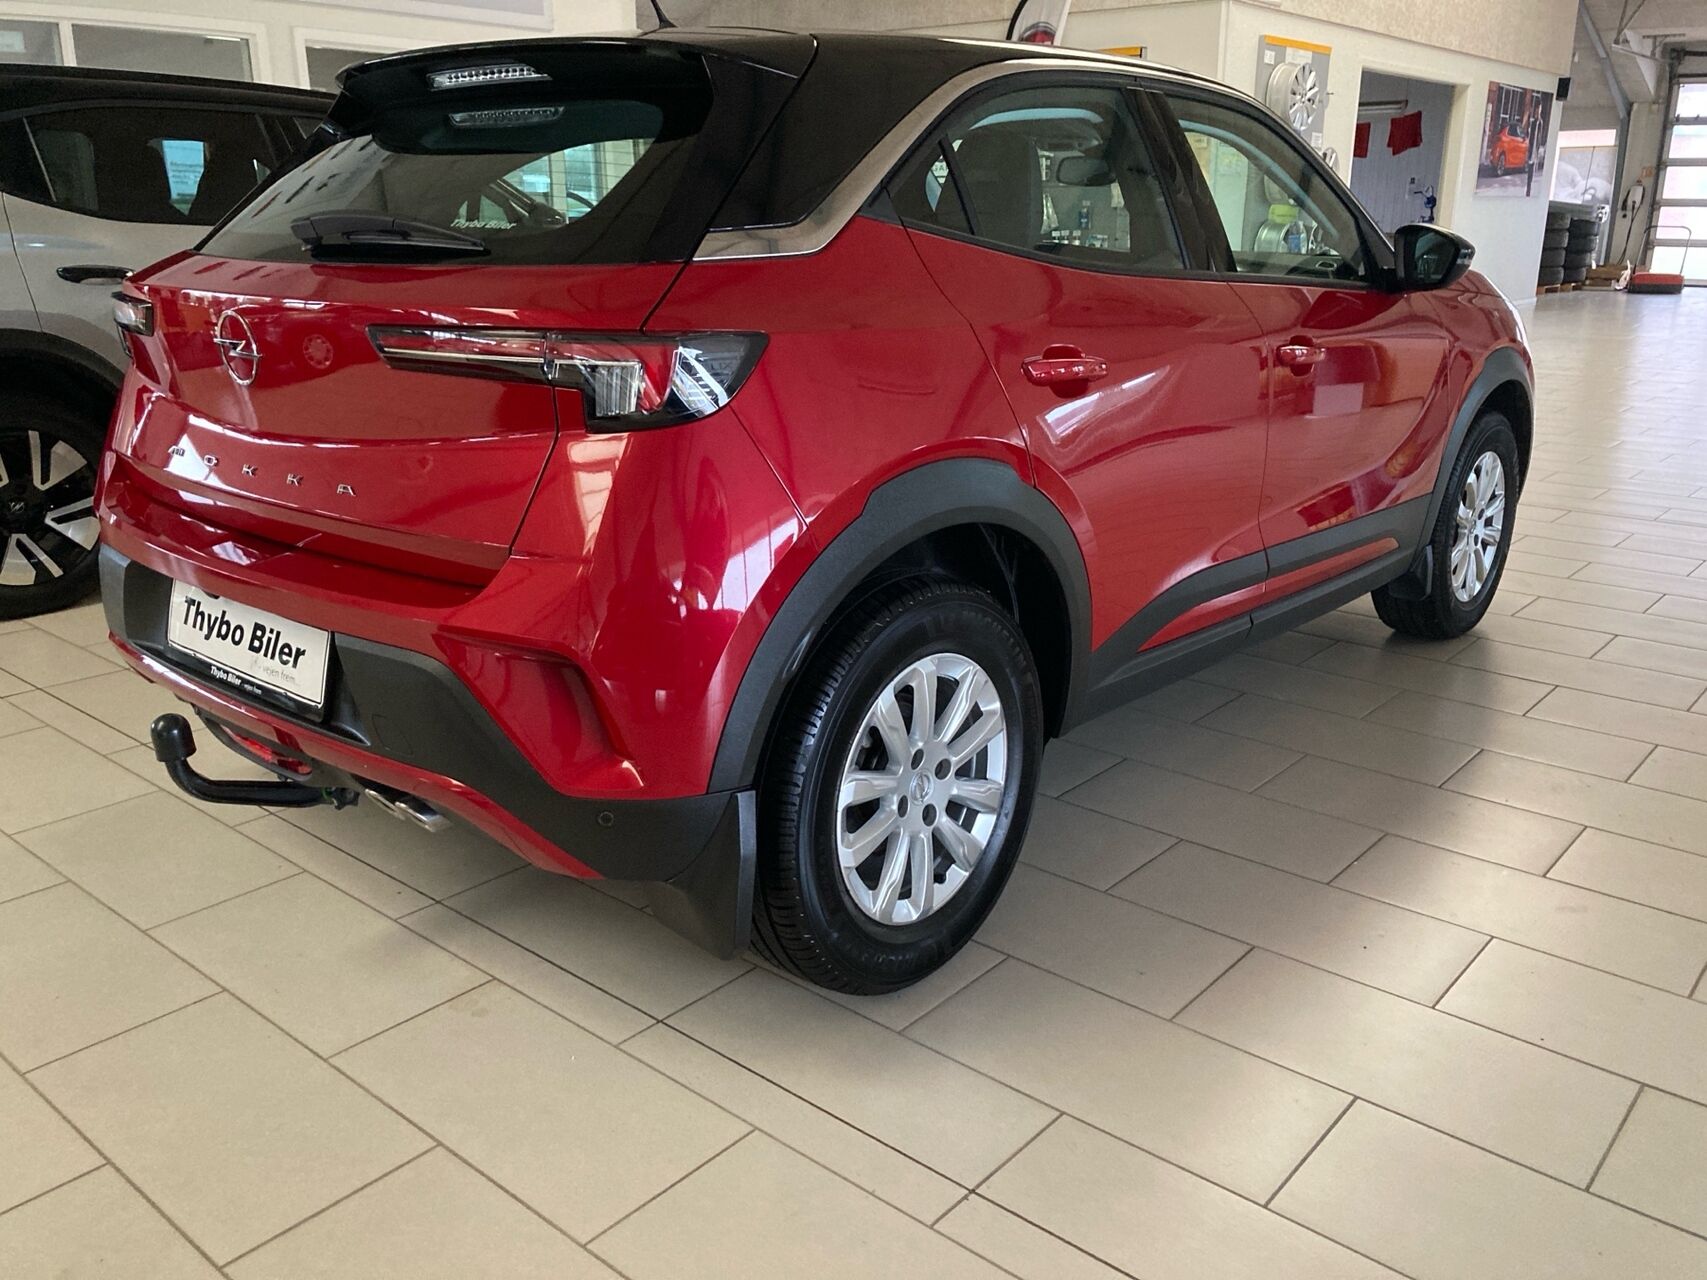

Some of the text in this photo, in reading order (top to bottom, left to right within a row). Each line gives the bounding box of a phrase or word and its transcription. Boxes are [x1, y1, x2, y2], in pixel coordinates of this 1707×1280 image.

[184, 595, 306, 669] Thybo Biler
[210, 665, 228, 679] Thybo
[227, 673, 242, 686] Biler
